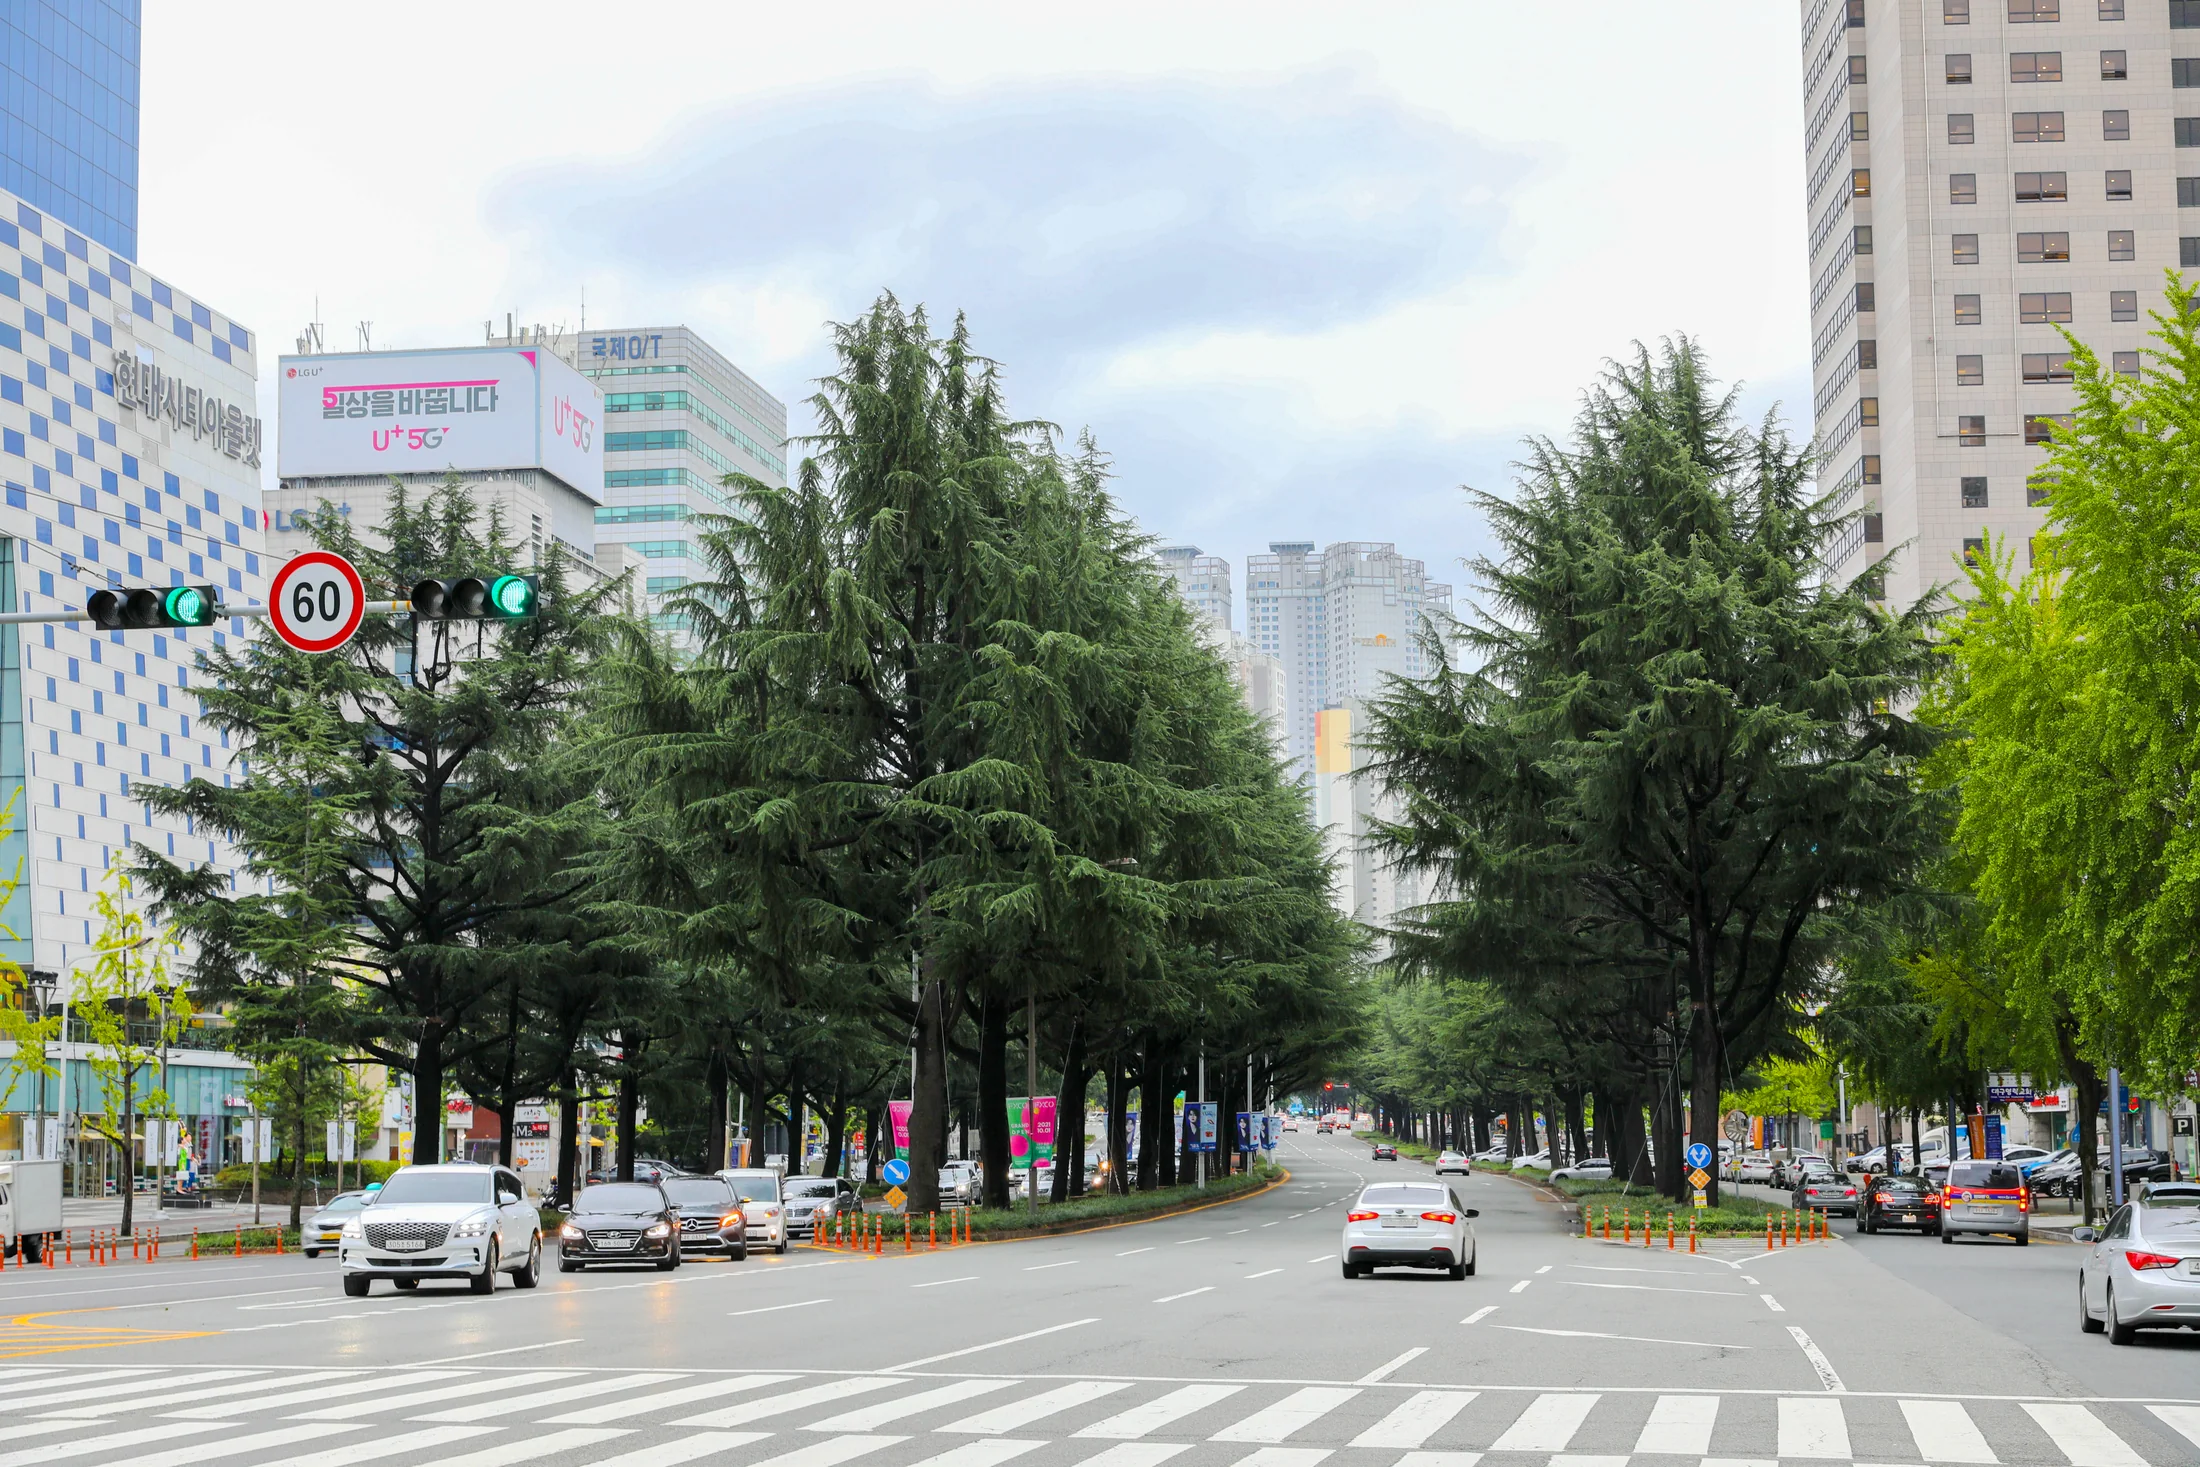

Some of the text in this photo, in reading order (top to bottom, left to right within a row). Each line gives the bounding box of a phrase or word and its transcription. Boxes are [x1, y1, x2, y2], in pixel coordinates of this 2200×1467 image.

[399, 386, 499, 416] 바꿉니다
[408, 427, 447, 450] 5G
[292, 580, 341, 623] 60
[2177, 1119, 2189, 1133] P
